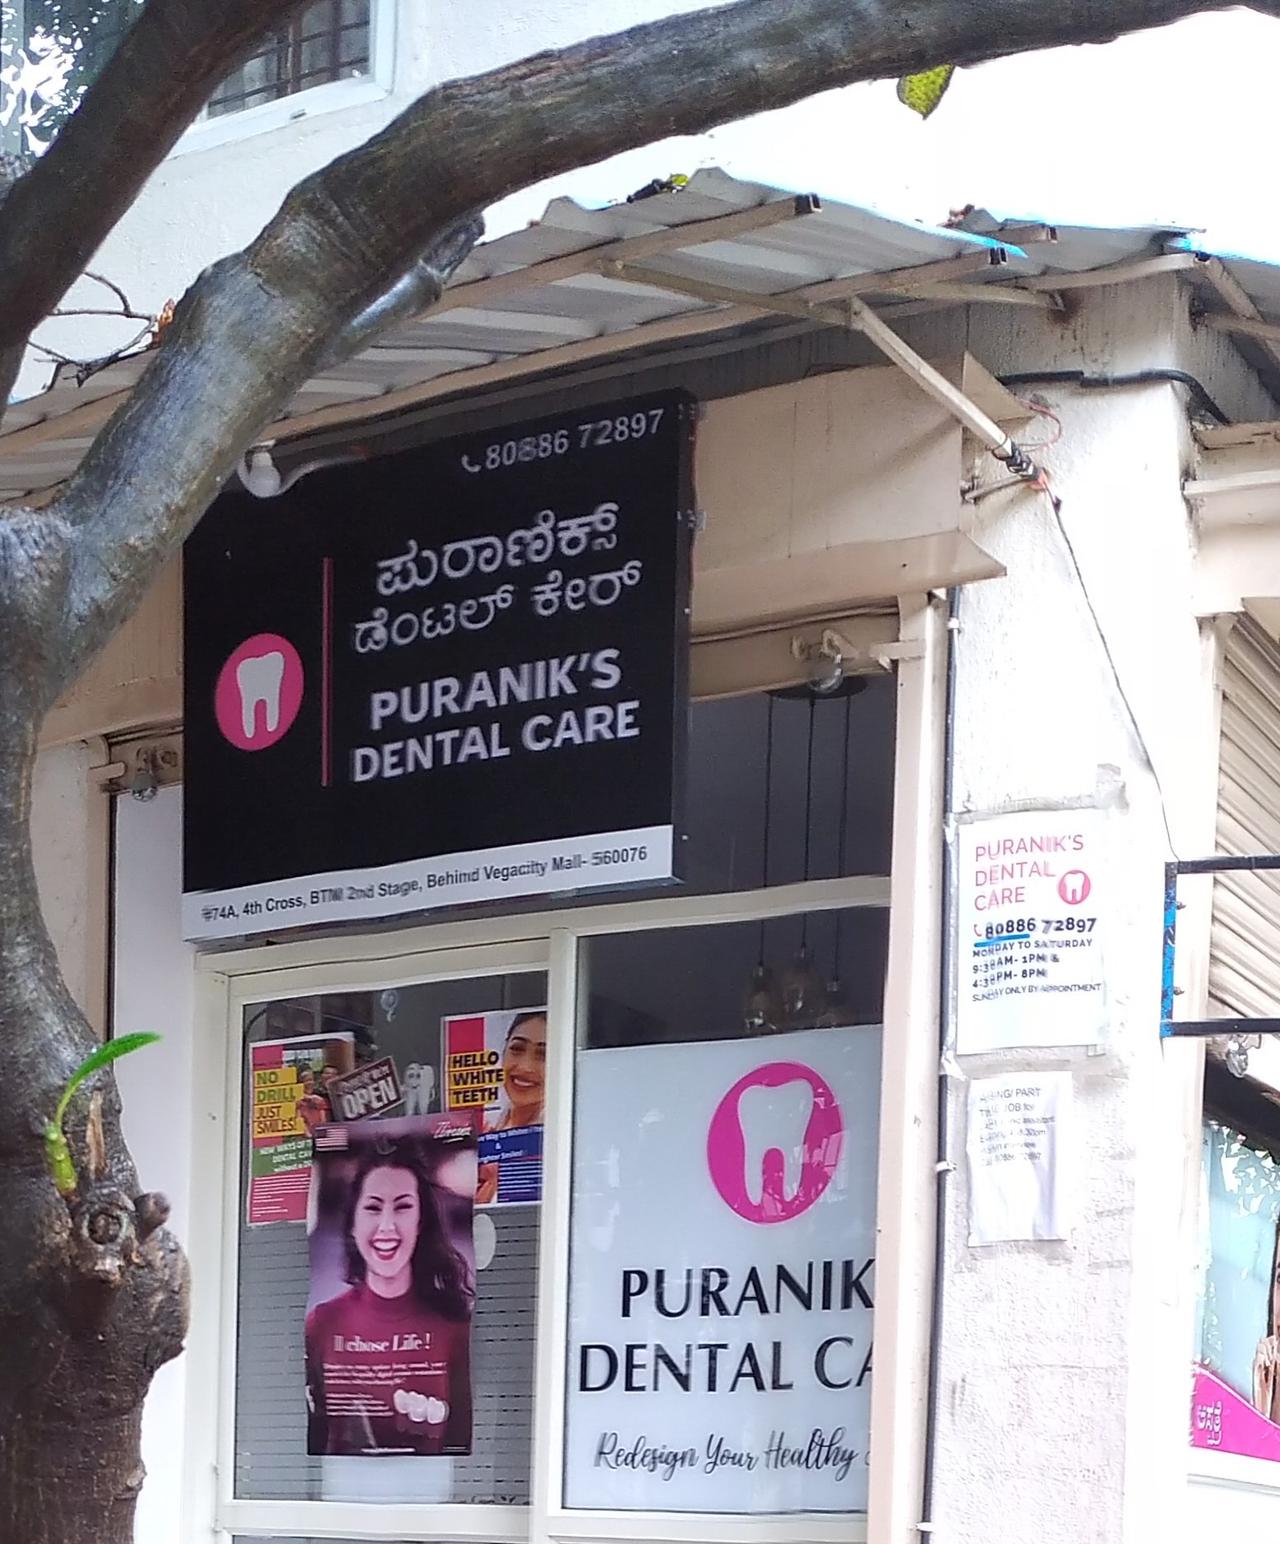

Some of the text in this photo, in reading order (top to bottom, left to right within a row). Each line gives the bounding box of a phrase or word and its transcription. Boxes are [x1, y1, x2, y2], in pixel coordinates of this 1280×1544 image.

[486, 408, 664, 469] 80886 72897
[354, 560, 643, 653] ಡೆಂಟಲ್ ಕೇರ್
[370, 648, 621, 731] PURANIK'S
[352, 701, 640, 783] DENTAL CARE
[975, 834, 1084, 862] PURANIK'S
[242, 901, 262, 916] 4th
[265, 895, 307, 912] Cross,
[310, 887, 343, 904] BTM
[347, 884, 374, 900] 2nd
[377, 878, 423, 897] Stage,
[427, 867, 479, 888] Behind
[483, 861, 548, 881] Vegacity
[591, 846, 648, 866] 560076
[975, 861, 1055, 887] DENTAL
[974, 887, 1025, 911] CARE
[985, 917, 1097, 939] 80886 72897
[972, 939, 1093, 957] MONDAY TO SATURDAY
[1022, 953, 1047, 964] 1PM
[1021, 968, 1048, 978] 8PM
[1005, 985, 1026, 995] ONLY
[1028, 984, 1038, 993] BY
[453, 1051, 499, 1068] HELLO
[256, 1071, 278, 1085] NO
[453, 1069, 504, 1086] WHITE
[256, 1088, 296, 1102] DRILL
[342, 1076, 397, 1119] OPEN
[453, 1087, 498, 1104] TEETH
[1015, 1087, 1041, 1097] PART
[256, 1106, 282, 1120] JUST
[578, 1340, 793, 1394] DENTAL
[594, 1431, 698, 1481] Redesign
[705, 1433, 759, 1475] Your
[764, 1426, 860, 1481] Healthy
